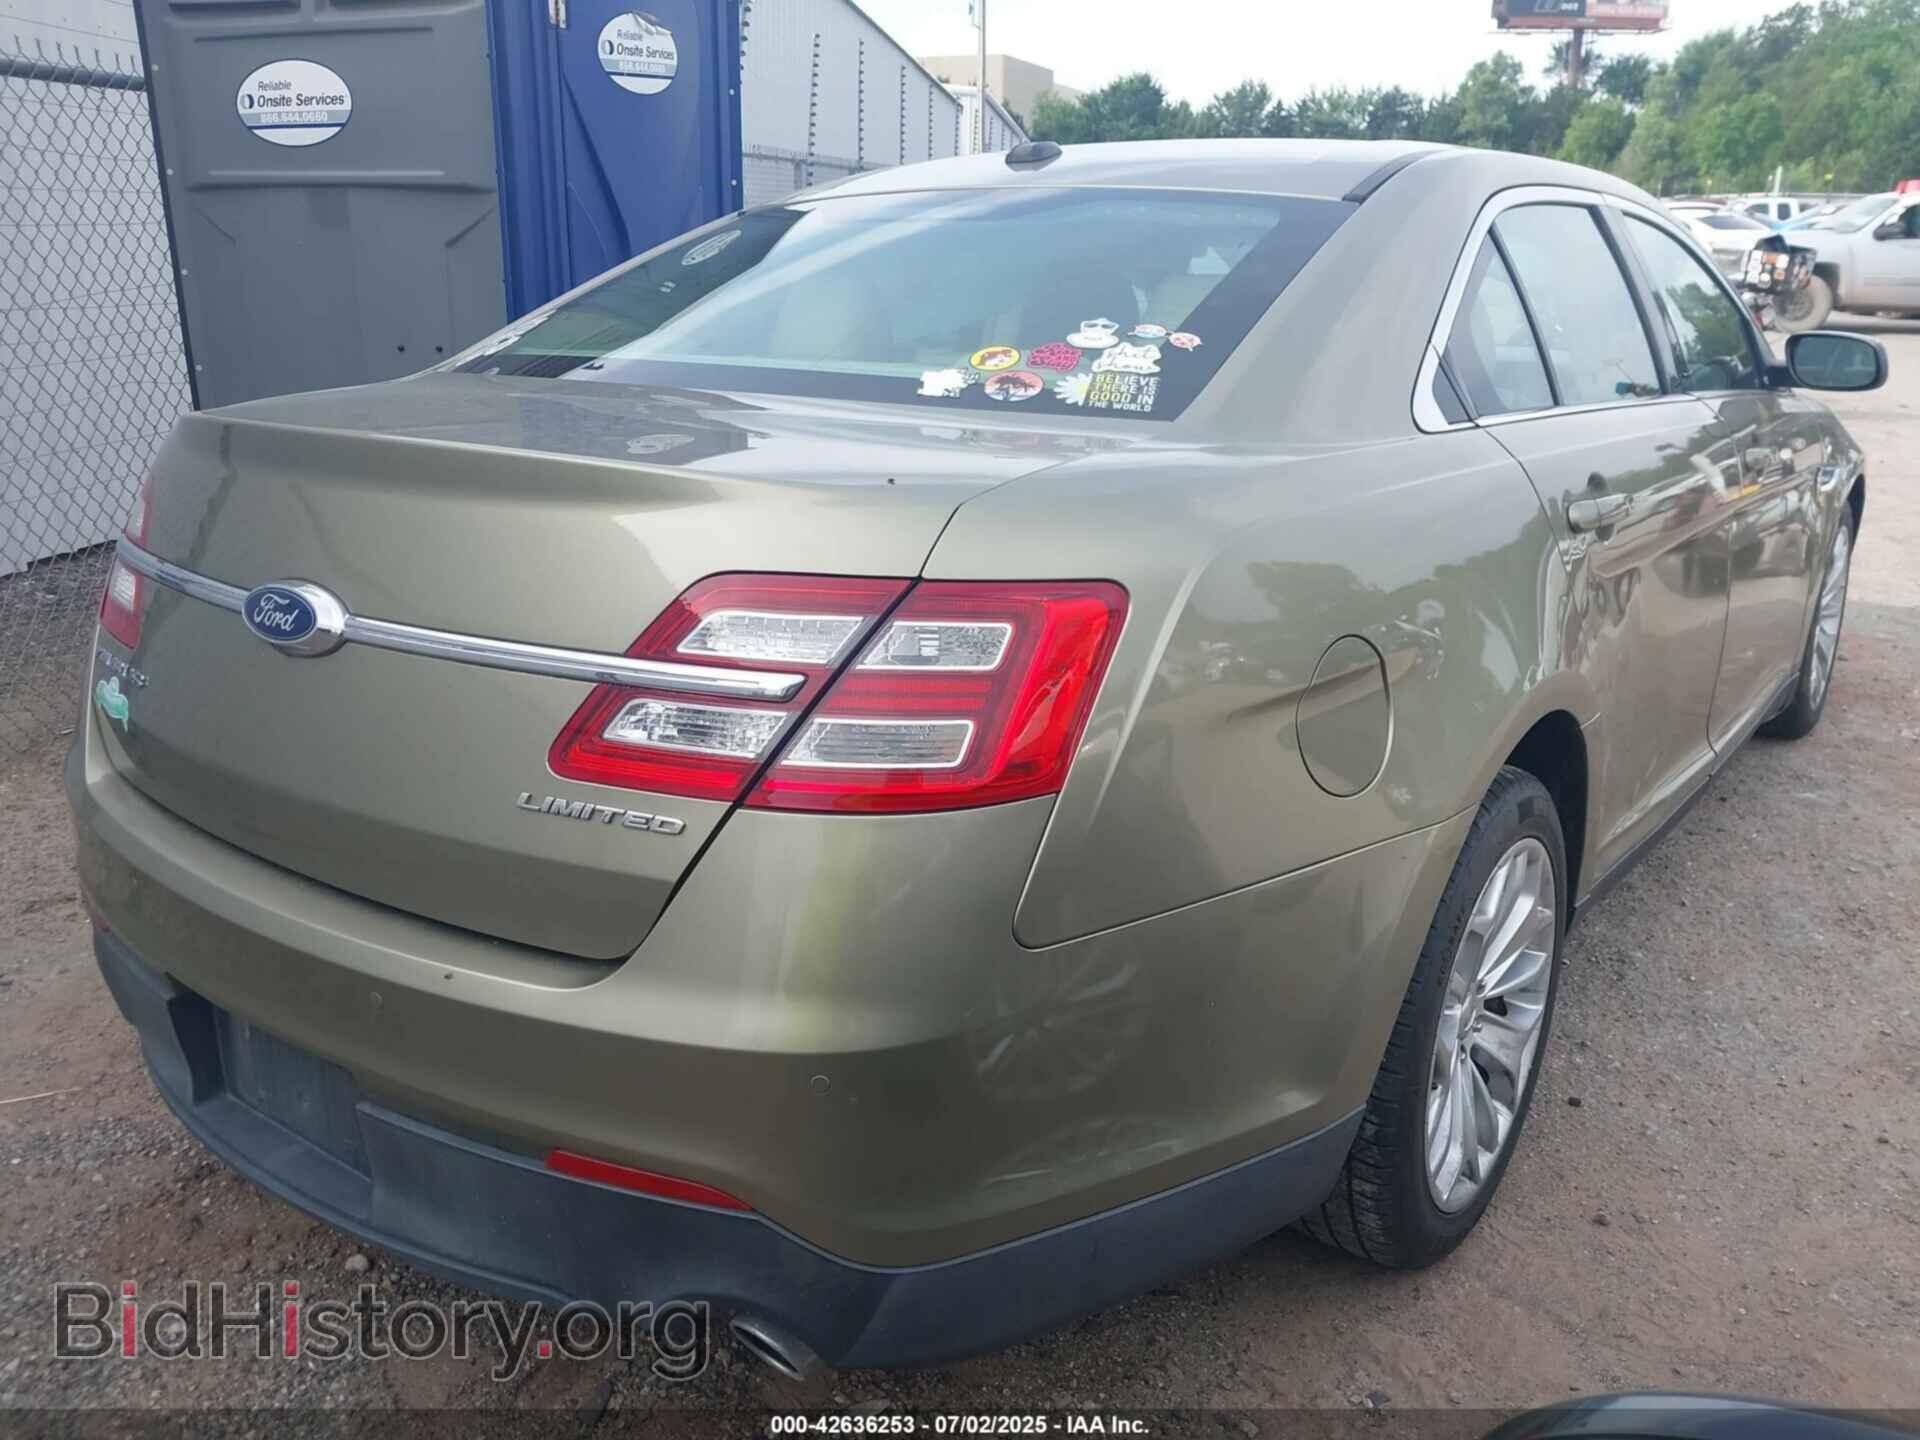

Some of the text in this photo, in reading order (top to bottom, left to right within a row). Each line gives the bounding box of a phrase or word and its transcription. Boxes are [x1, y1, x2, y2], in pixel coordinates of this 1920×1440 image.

[617, 42, 675, 60] Onsite Services
[257, 80, 292, 92] Reliable
[257, 93, 345, 108] Onsite Services
[1096, 374, 1159, 386] BELIEVE
[1094, 383, 1157, 396] THERE IS
[1090, 391, 1154, 405] GOOD IN
[1088, 400, 1152, 412] THE WORLD
[253, 593, 300, 632] Ford
[515, 791, 687, 836] LIMITED
